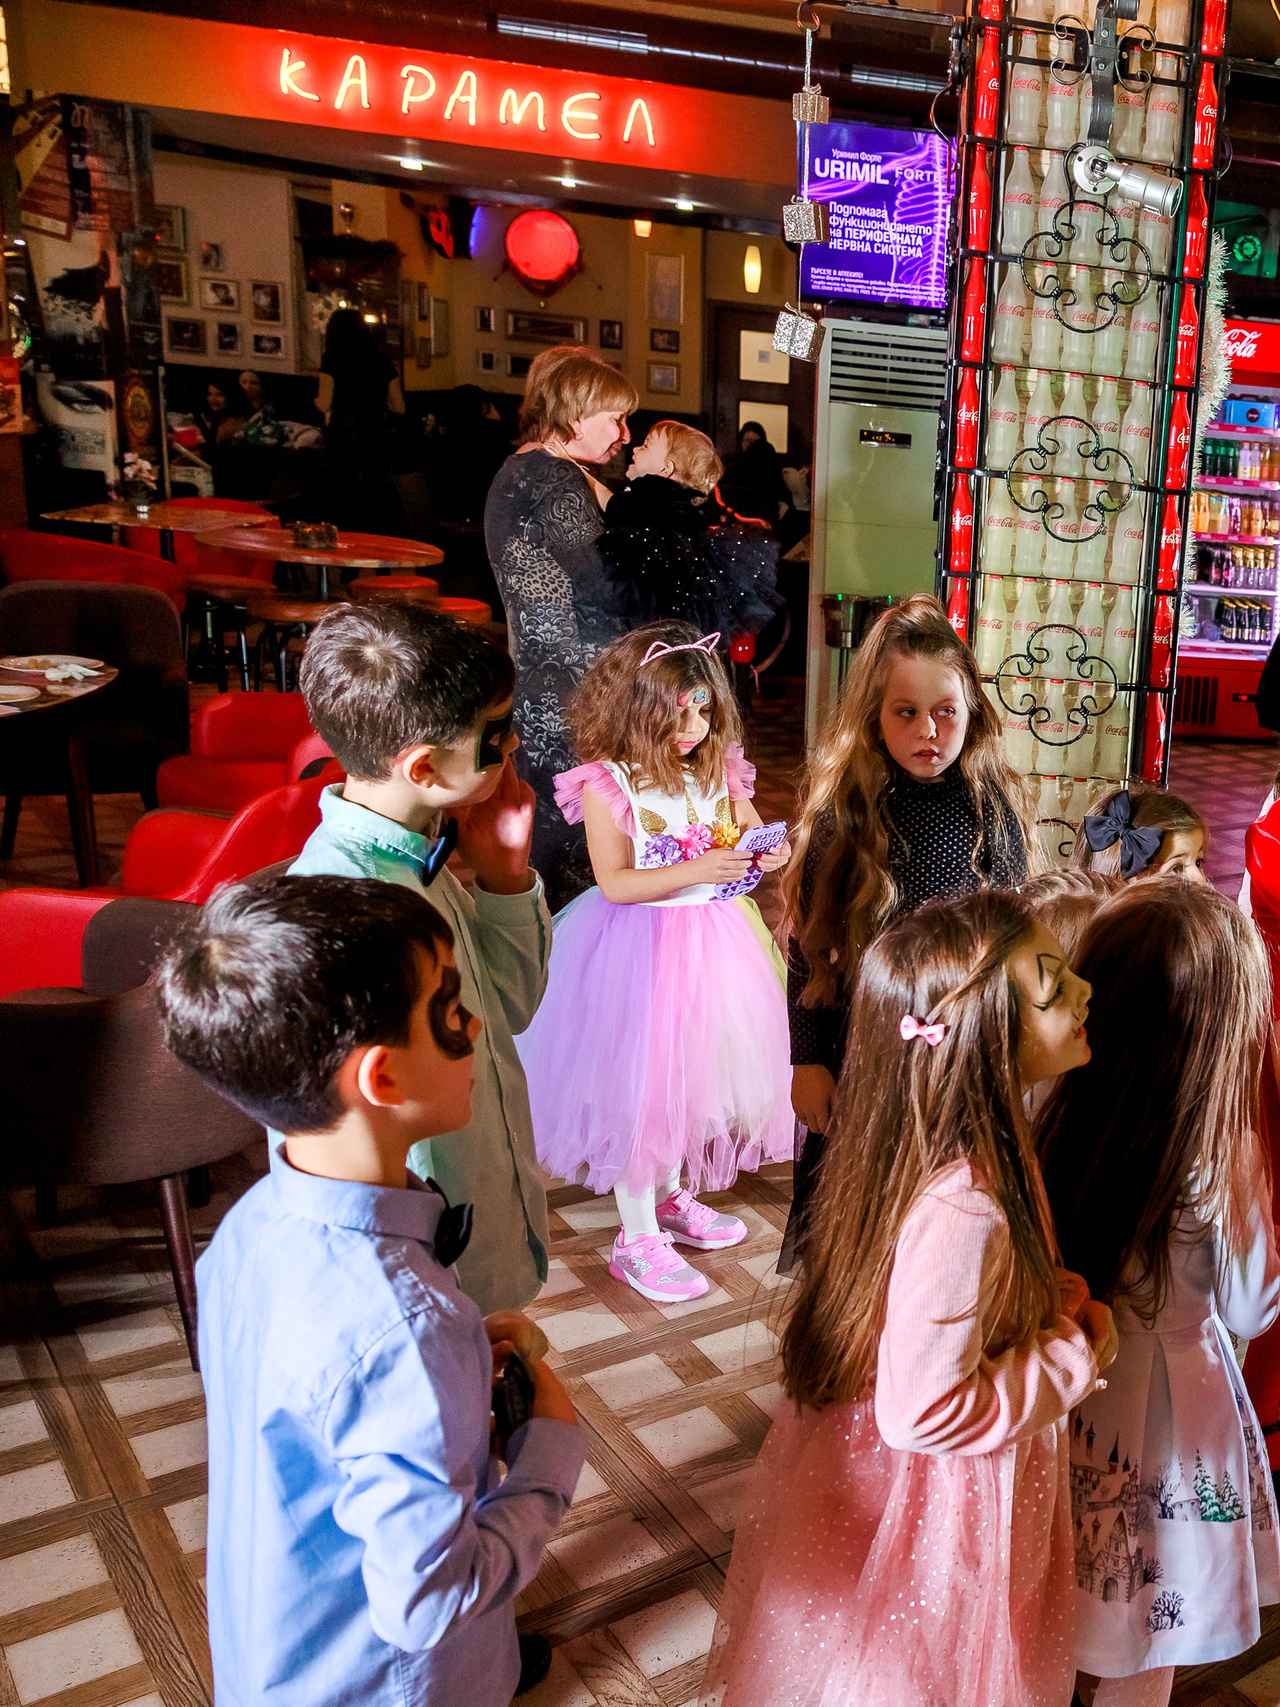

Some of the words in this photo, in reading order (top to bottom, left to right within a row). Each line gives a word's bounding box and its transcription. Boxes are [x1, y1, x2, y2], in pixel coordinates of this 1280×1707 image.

[279, 48, 656, 147] КАРАМЕЛ
[832, 148, 859, 160] Уримил
[860, 151, 882, 163] Форте
[814, 157, 890, 185] URIMIL
[895, 167, 940, 182] FORTE
[829, 201, 887, 219] Подпомага
[829, 215, 933, 236] функционирането
[829, 228, 842, 238] на
[845, 227, 923, 247] ПЕРИФЕРНАТА
[829, 238, 872, 254] НЕРВНА
[873, 242, 923, 259] СИСТЕМА
